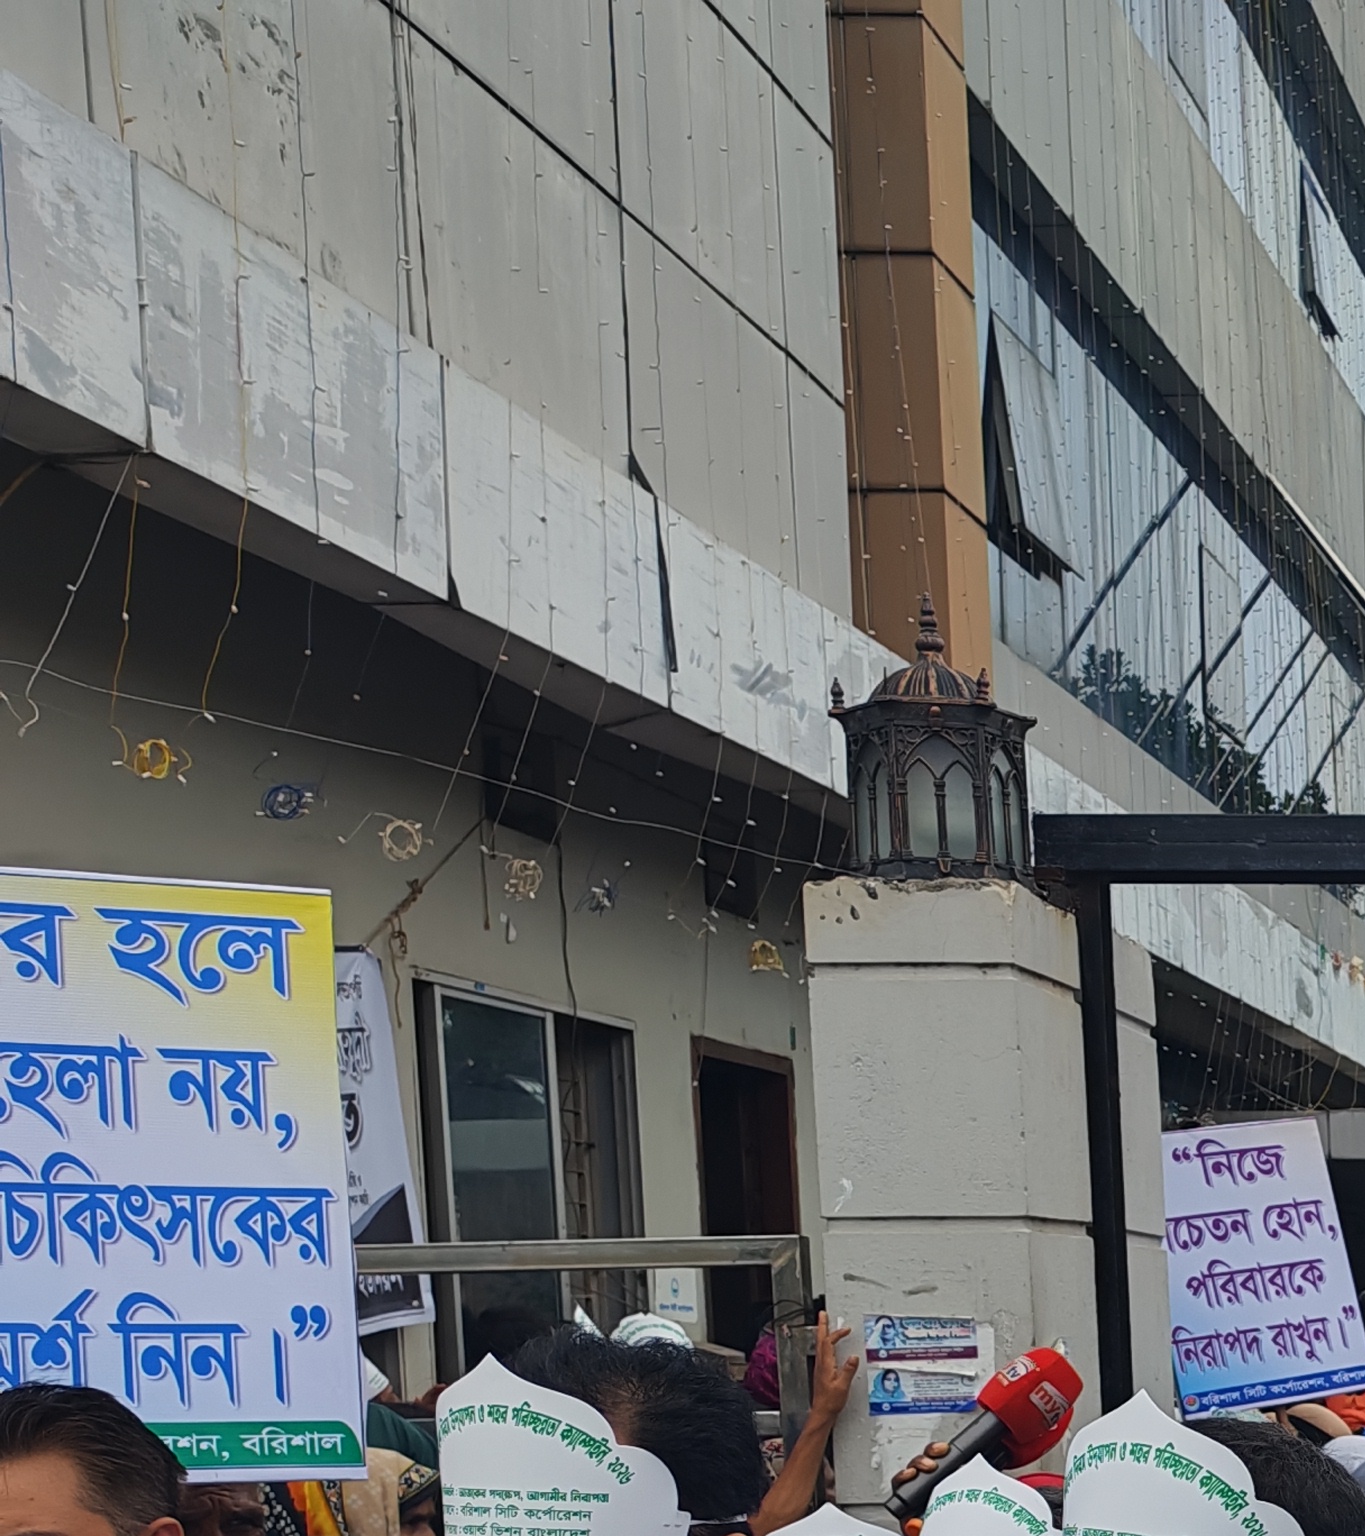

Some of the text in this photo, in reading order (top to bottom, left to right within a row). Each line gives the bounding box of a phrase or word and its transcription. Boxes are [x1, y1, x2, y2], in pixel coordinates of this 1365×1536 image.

[94, 907, 304, 1007] হলে
[155, 1047, 297, 1151] নয়,
[1172, 1138, 1287, 1188] “নিজে
[1165, 1197, 1339, 1253] চেতন হোন,
[1186, 1259, 1326, 1309] পরিবারকে
[107, 1292, 248, 1408] নিন
[1171, 1325, 1264, 1374] নিরাপদ
[1266, 1314, 1333, 1363] রাখুন
[1201, 1390, 1240, 1406] বরিশাল
[1244, 1385, 1267, 1399] সিটি
[1271, 1376, 1329, 1395] কর্পোরেশন,
[241, 1427, 346, 1457] বরিশাল
[460, 1503, 592, 1522] বরিশাল সিটি কর্পোরেশন
